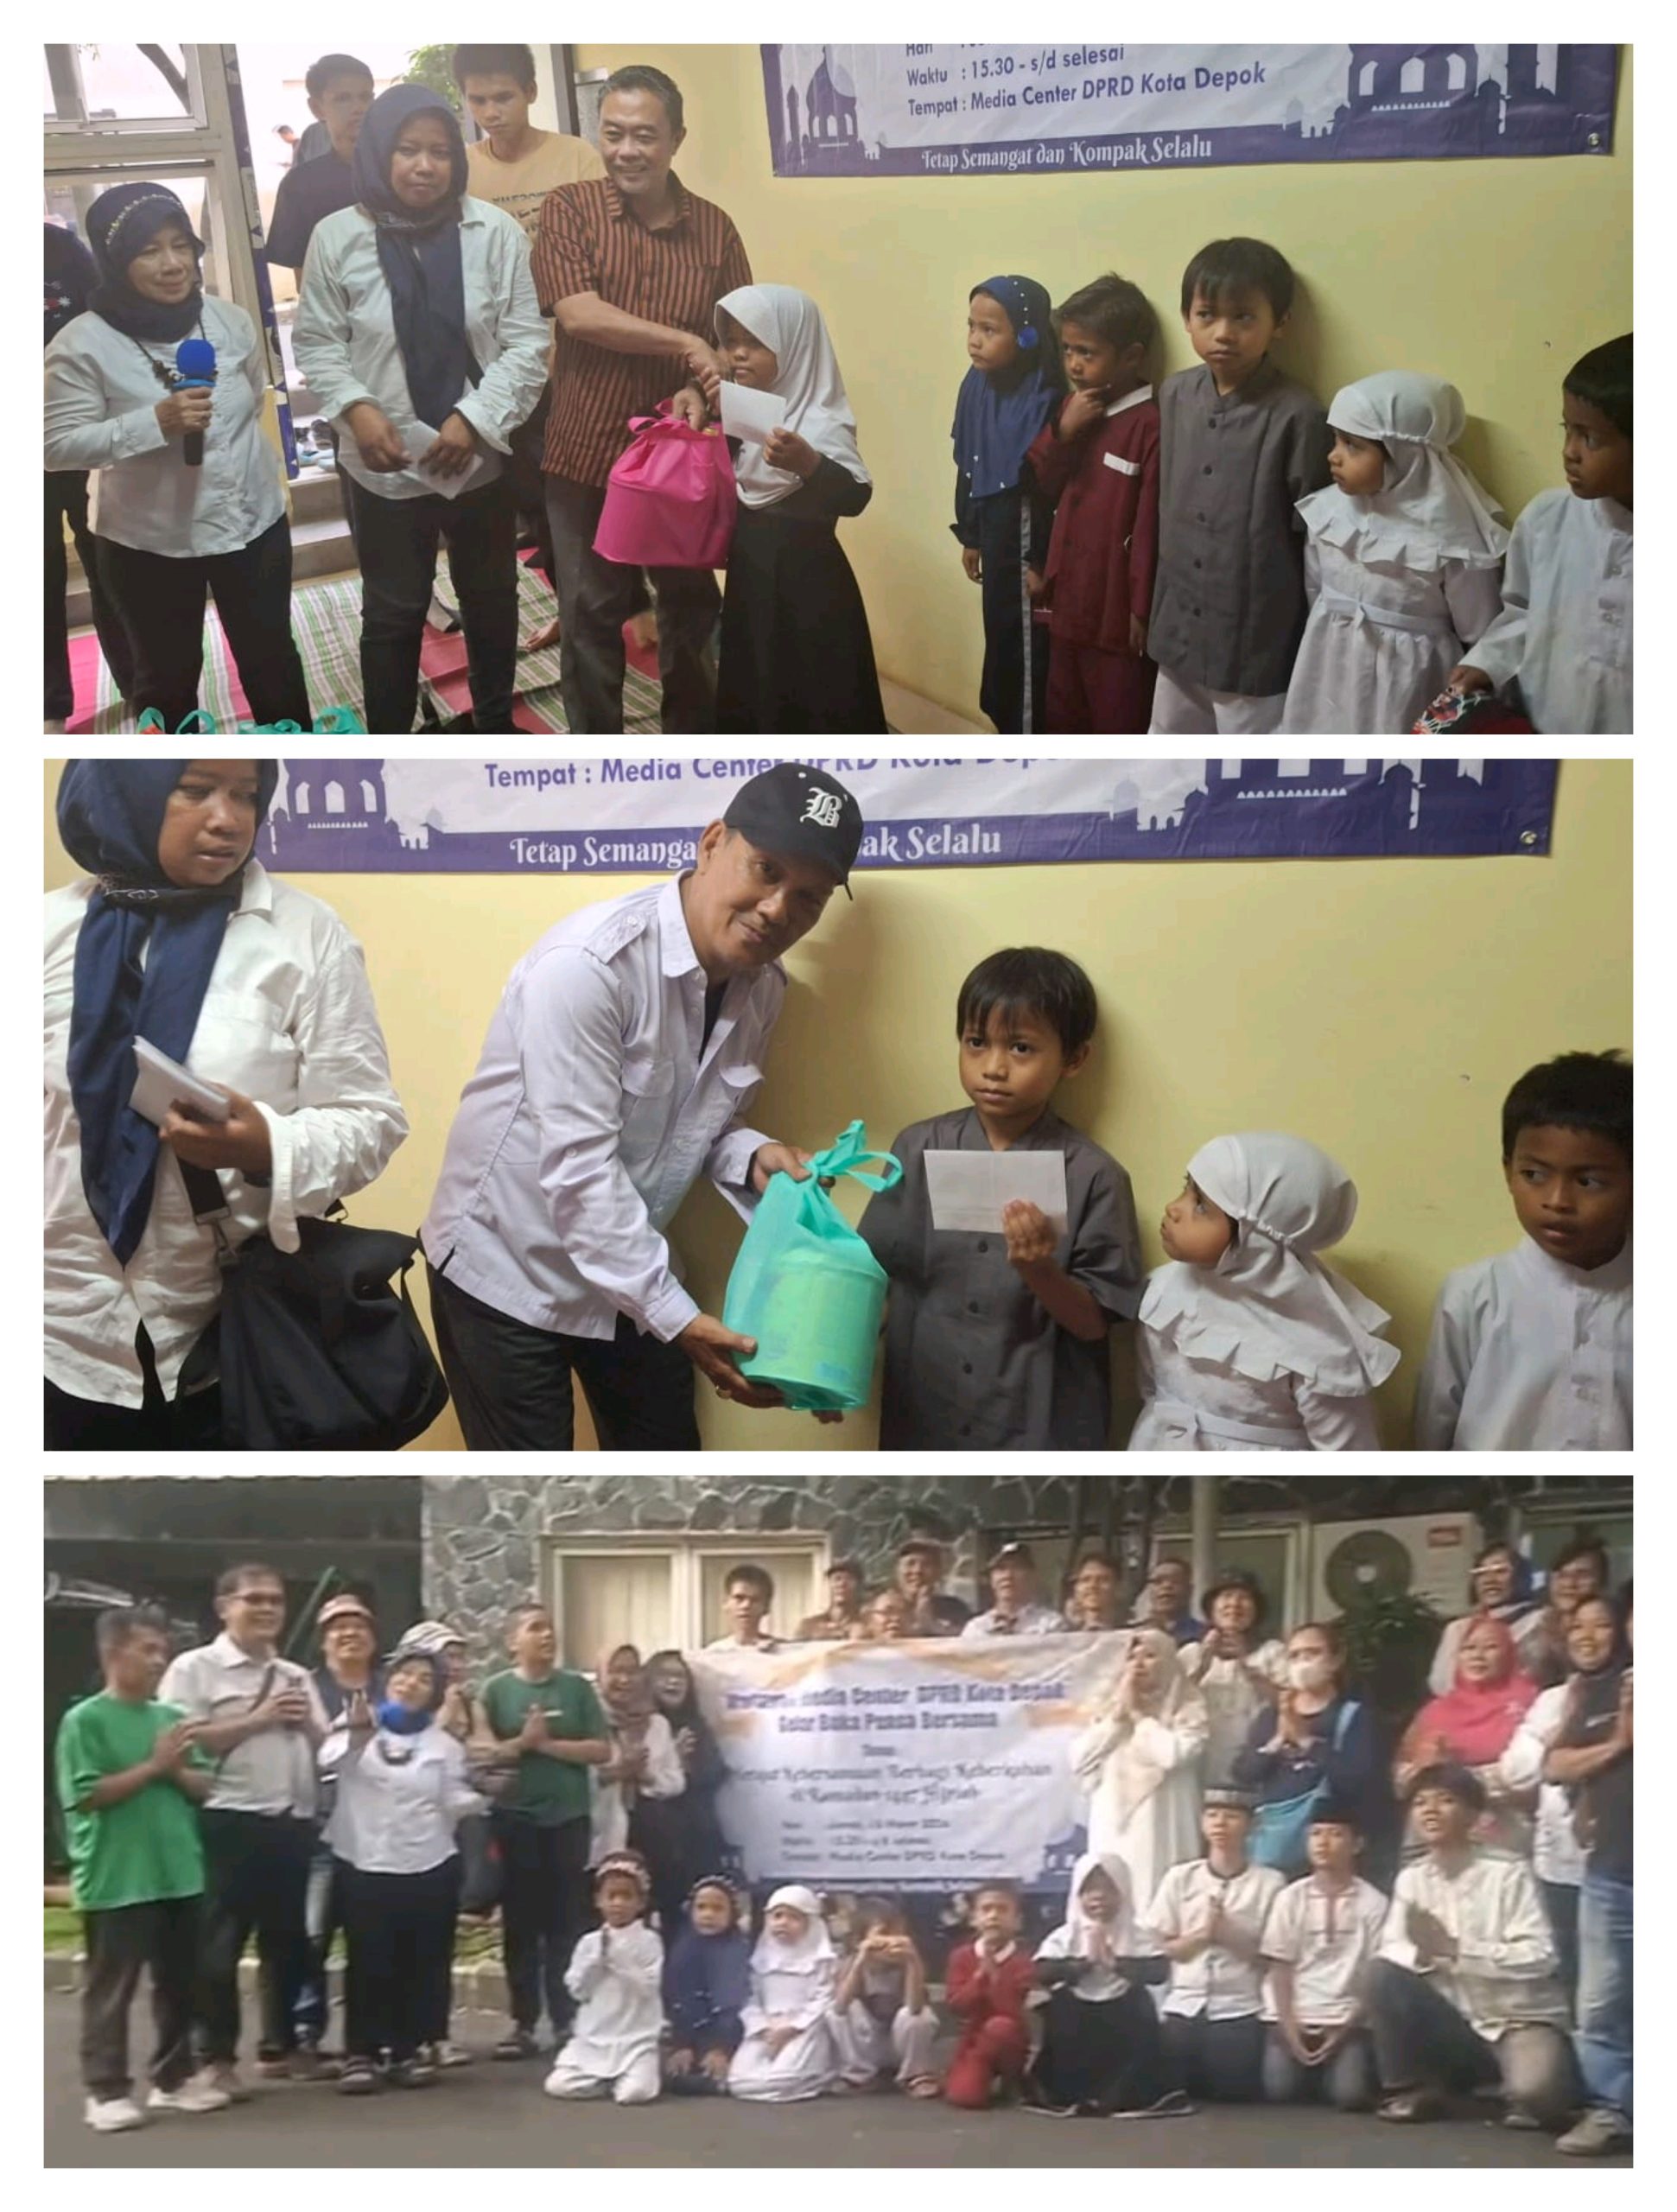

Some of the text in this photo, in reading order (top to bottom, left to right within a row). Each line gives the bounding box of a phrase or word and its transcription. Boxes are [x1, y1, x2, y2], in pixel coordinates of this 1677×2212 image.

[907, 67, 948, 86] Waktu
[972, 57, 1014, 79] 15.30
[1031, 49, 1056, 75] s/d
[1064, 44, 1124, 67] selesai
[908, 97, 957, 118] Tempat
[971, 90, 1016, 111] Media
[1023, 86, 1077, 105] Center
[1083, 75, 1134, 99] DPRD
[1141, 73, 1185, 93] Kota
[1195, 61, 1266, 92] Depok
[921, 134, 1211, 173] Tetap Semangat dan Kompak Selalu
[485, 763, 576, 791] Tempat
[600, 759, 681, 783] Media
[510, 838, 577, 871] Tetap
[583, 836, 697, 869] Semanga
[905, 823, 1000, 860] Selalu
